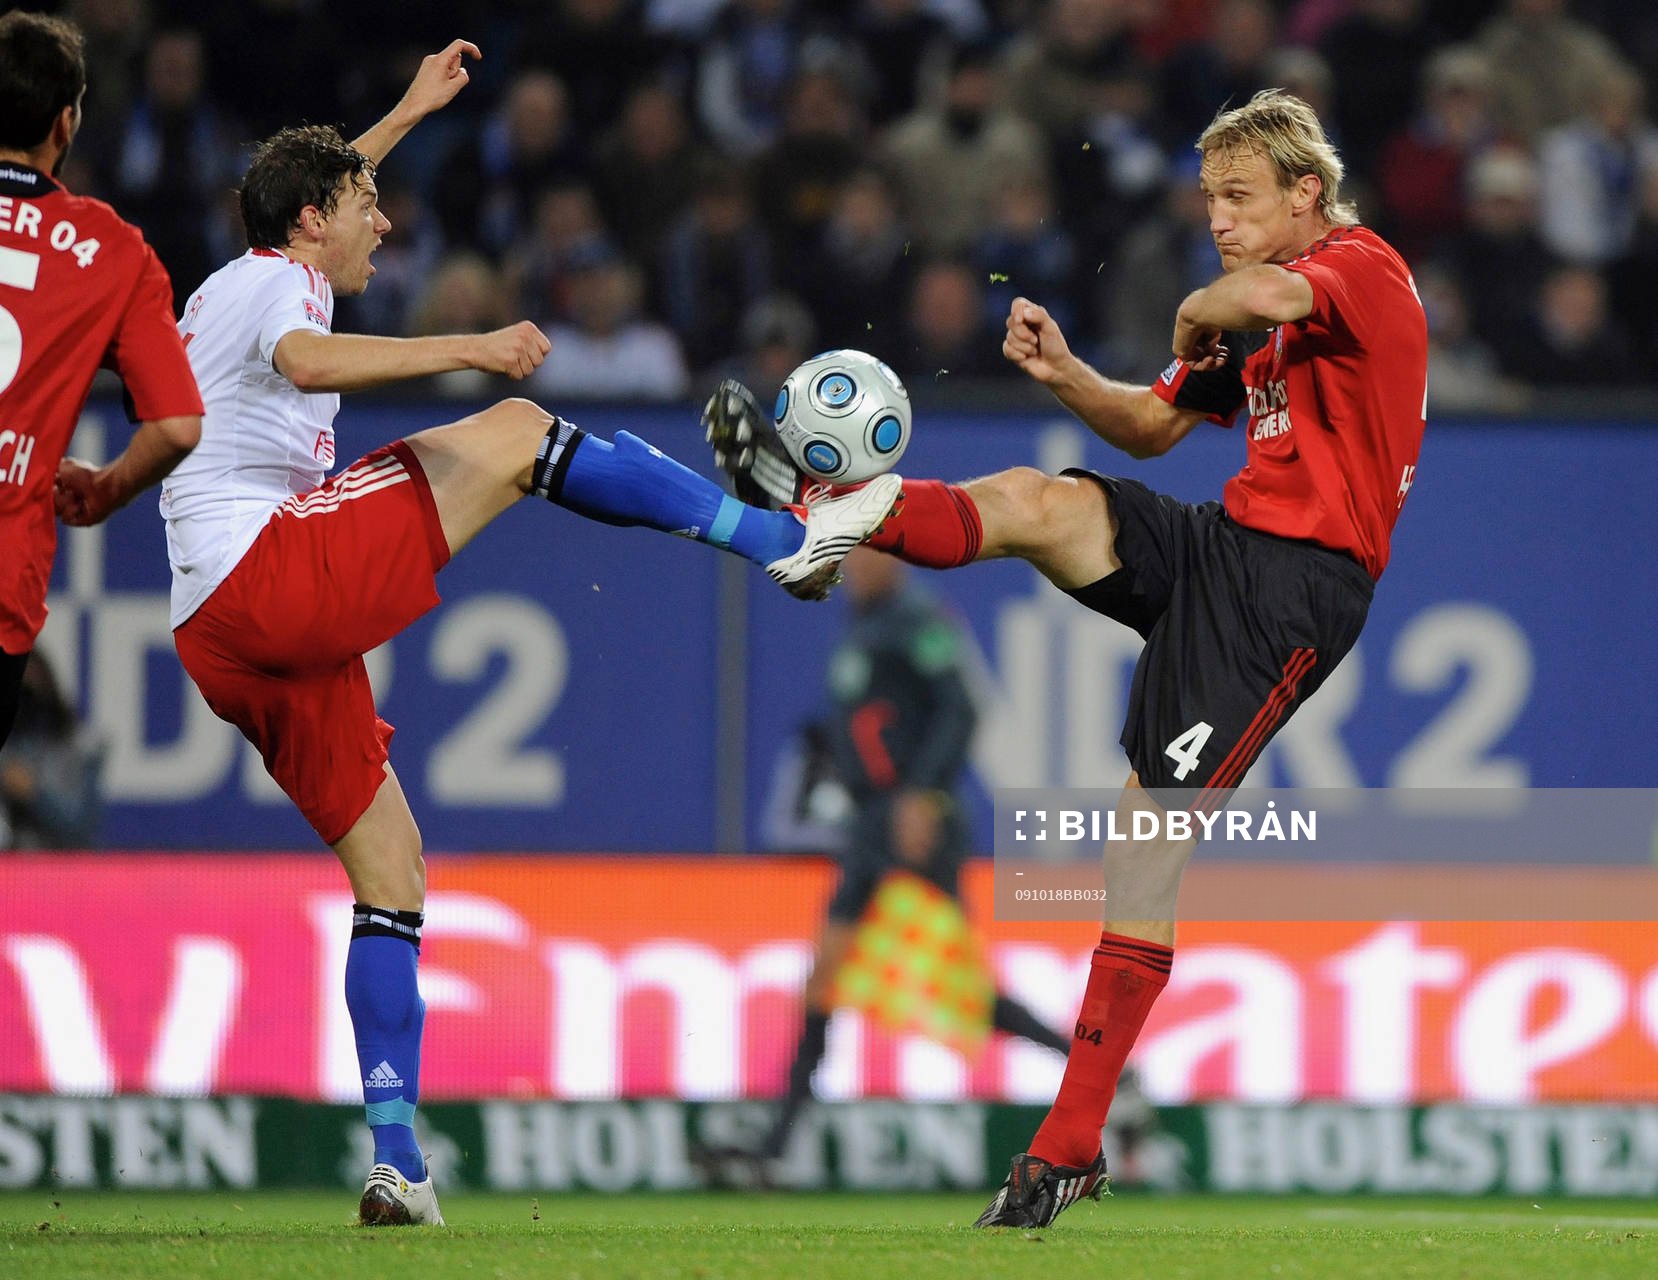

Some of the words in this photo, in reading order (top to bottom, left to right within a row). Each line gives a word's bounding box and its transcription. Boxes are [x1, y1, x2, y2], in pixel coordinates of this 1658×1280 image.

[50, 220, 101, 269] 04
[1164, 721, 1214, 782] 4
[364, 1078, 404, 1089] adidas
